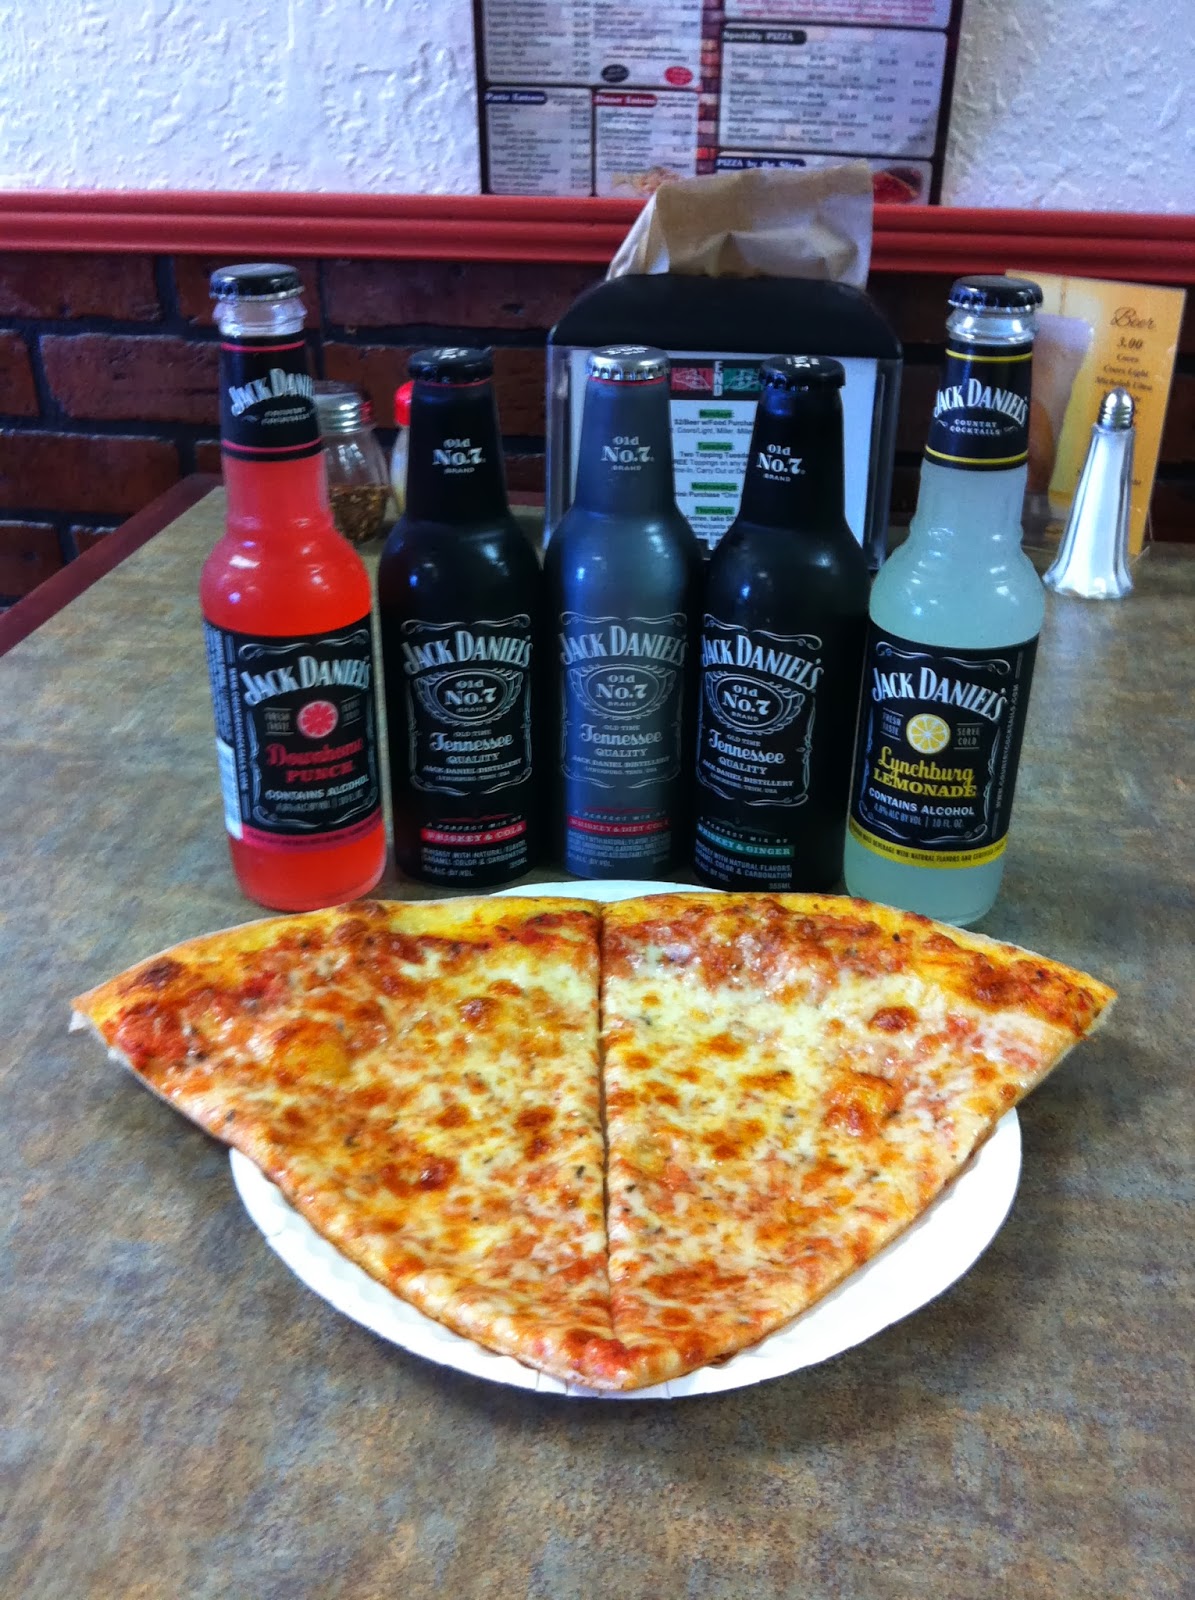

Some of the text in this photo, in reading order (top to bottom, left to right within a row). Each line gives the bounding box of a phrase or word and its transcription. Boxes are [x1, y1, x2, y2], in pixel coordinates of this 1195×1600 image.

[229, 376, 273, 417] JACK
[934, 385, 965, 418] JACK
[949, 425, 1001, 435] COCKTAILS
[953, 419, 998, 428] COUNTRY
[443, 438, 471, 449] Old
[612, 436, 640, 446] Old
[766, 443, 791, 456] Old
[401, 640, 456, 675] JACK
[558, 632, 608, 666] JACK
[702, 634, 735, 668] JACK
[240, 666, 299, 706] JACK
[455, 680, 484, 688] Old
[607, 675, 636, 683] Old
[443, 687, 497, 706] No.7
[596, 683, 649, 700] No.7
[733, 684, 757, 697] Old
[872, 667, 1008, 723] JACK DANIEL'S
[722, 691, 771, 715] No.7
[429, 732, 514, 753] Tennessee
[580, 723, 663, 745] Tennessee
[594, 748, 648, 758] QUALITY
[708, 728, 786, 764] Tennessee
[446, 752, 500, 765] QUALITY
[718, 756, 768, 775] QUALITY
[878, 746, 974, 787] Lynchburg
[716, 767, 742, 781] DANIEL
[743, 776, 794, 787] DISTILLERY
[873, 768, 977, 798] LEMONADE
[869, 787, 975, 816] CONTAINS ALCOHOL
[427, 831, 482, 843] WHISKEY
[485, 833, 493, 841] &
[736, 843, 744, 851] &
[746, 845, 790, 855] GINGER
